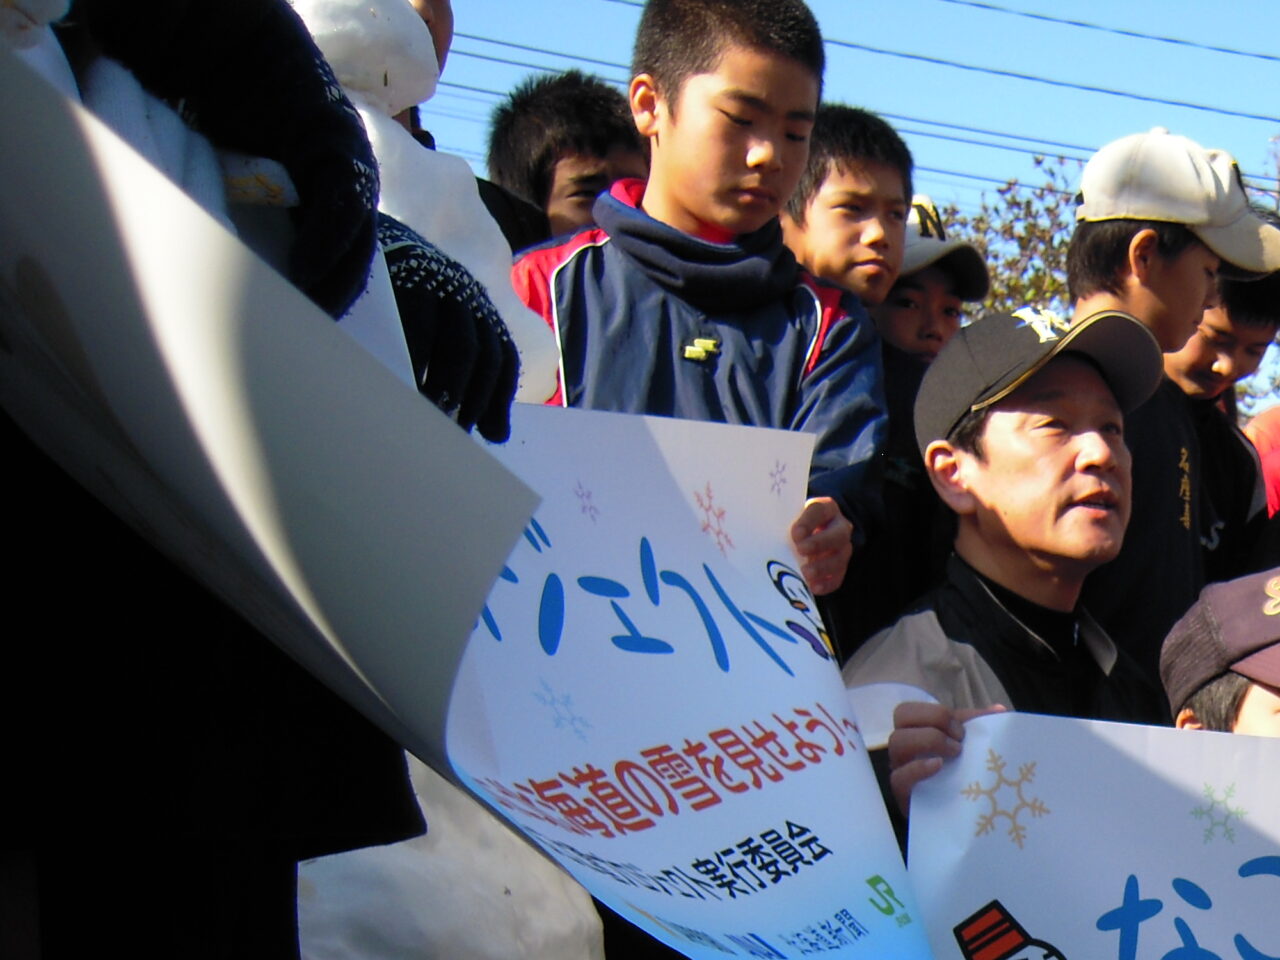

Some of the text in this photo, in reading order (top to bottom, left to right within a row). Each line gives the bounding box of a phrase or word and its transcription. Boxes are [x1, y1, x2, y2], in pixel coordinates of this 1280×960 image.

[473, 703, 859, 839] 海道の雪を見せよう!～
